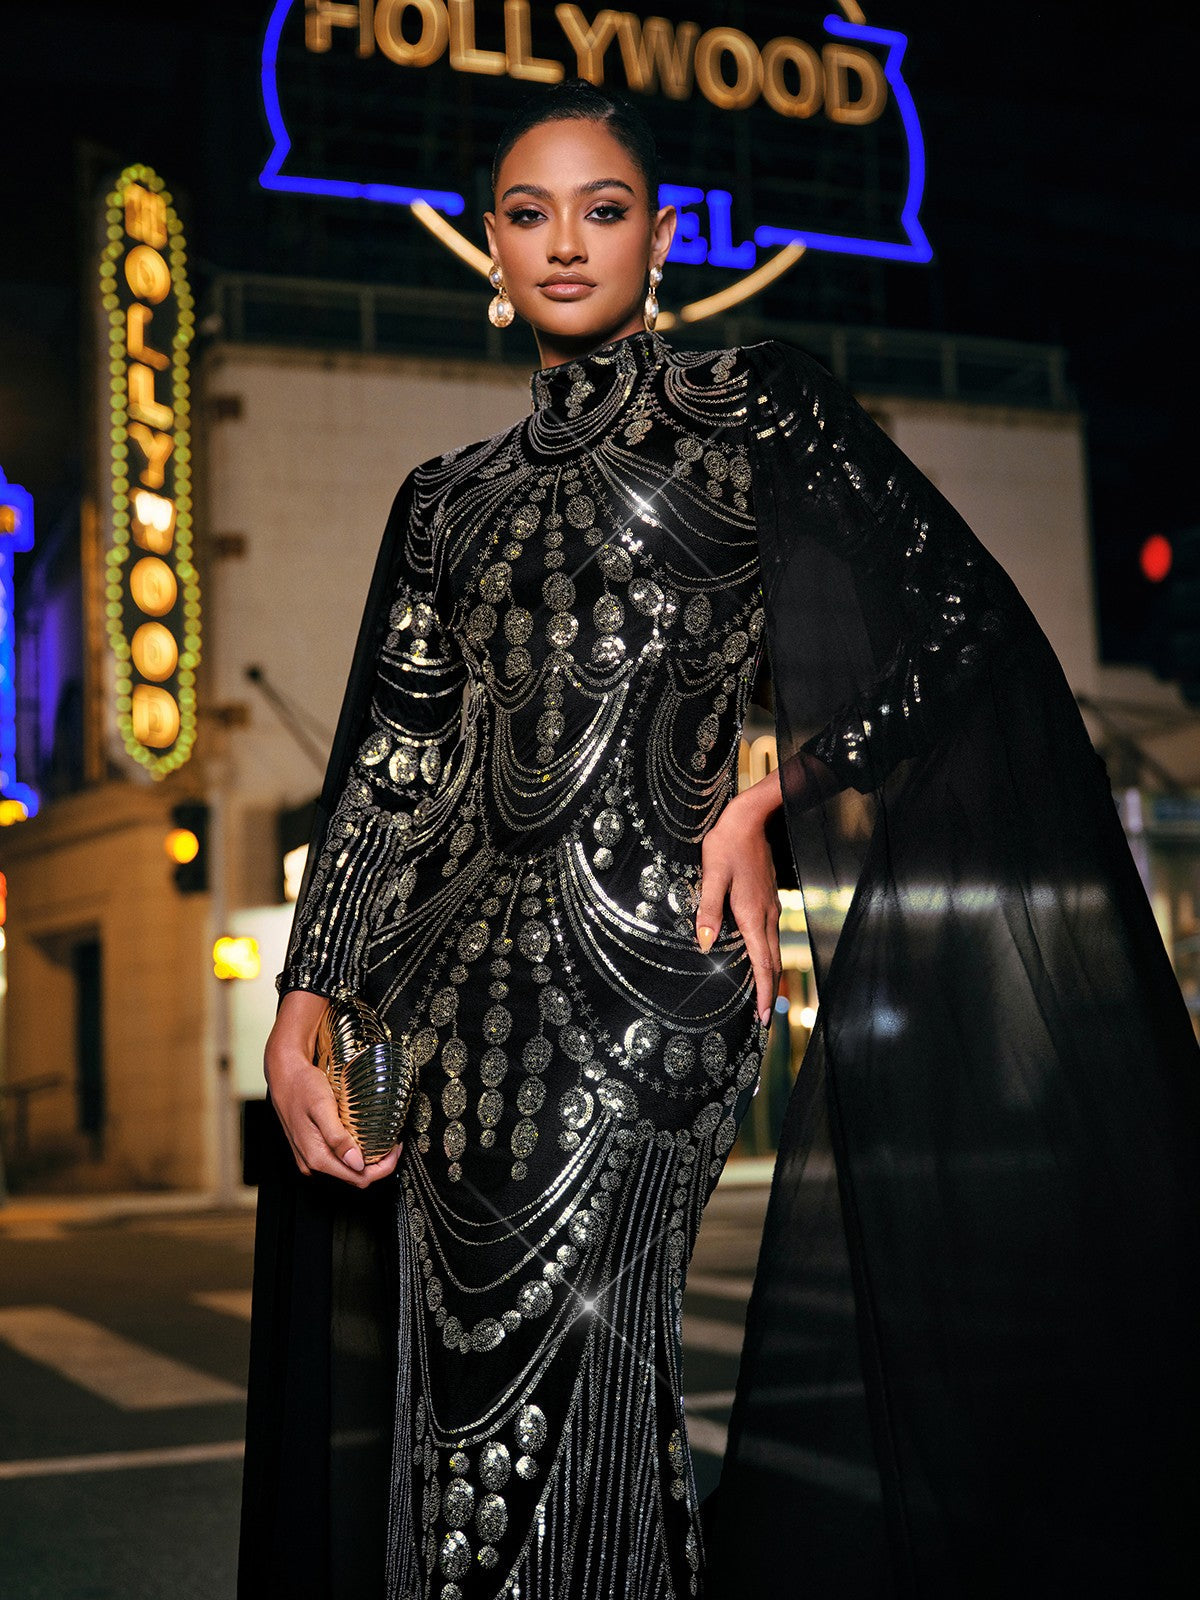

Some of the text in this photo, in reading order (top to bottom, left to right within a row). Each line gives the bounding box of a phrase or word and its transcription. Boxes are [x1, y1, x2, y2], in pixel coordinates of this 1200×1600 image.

[305, 0, 887, 126] HOLLYWOOD
[657, 183, 757, 270] EL
[124, 182, 181, 749] HOLLYWOOD
